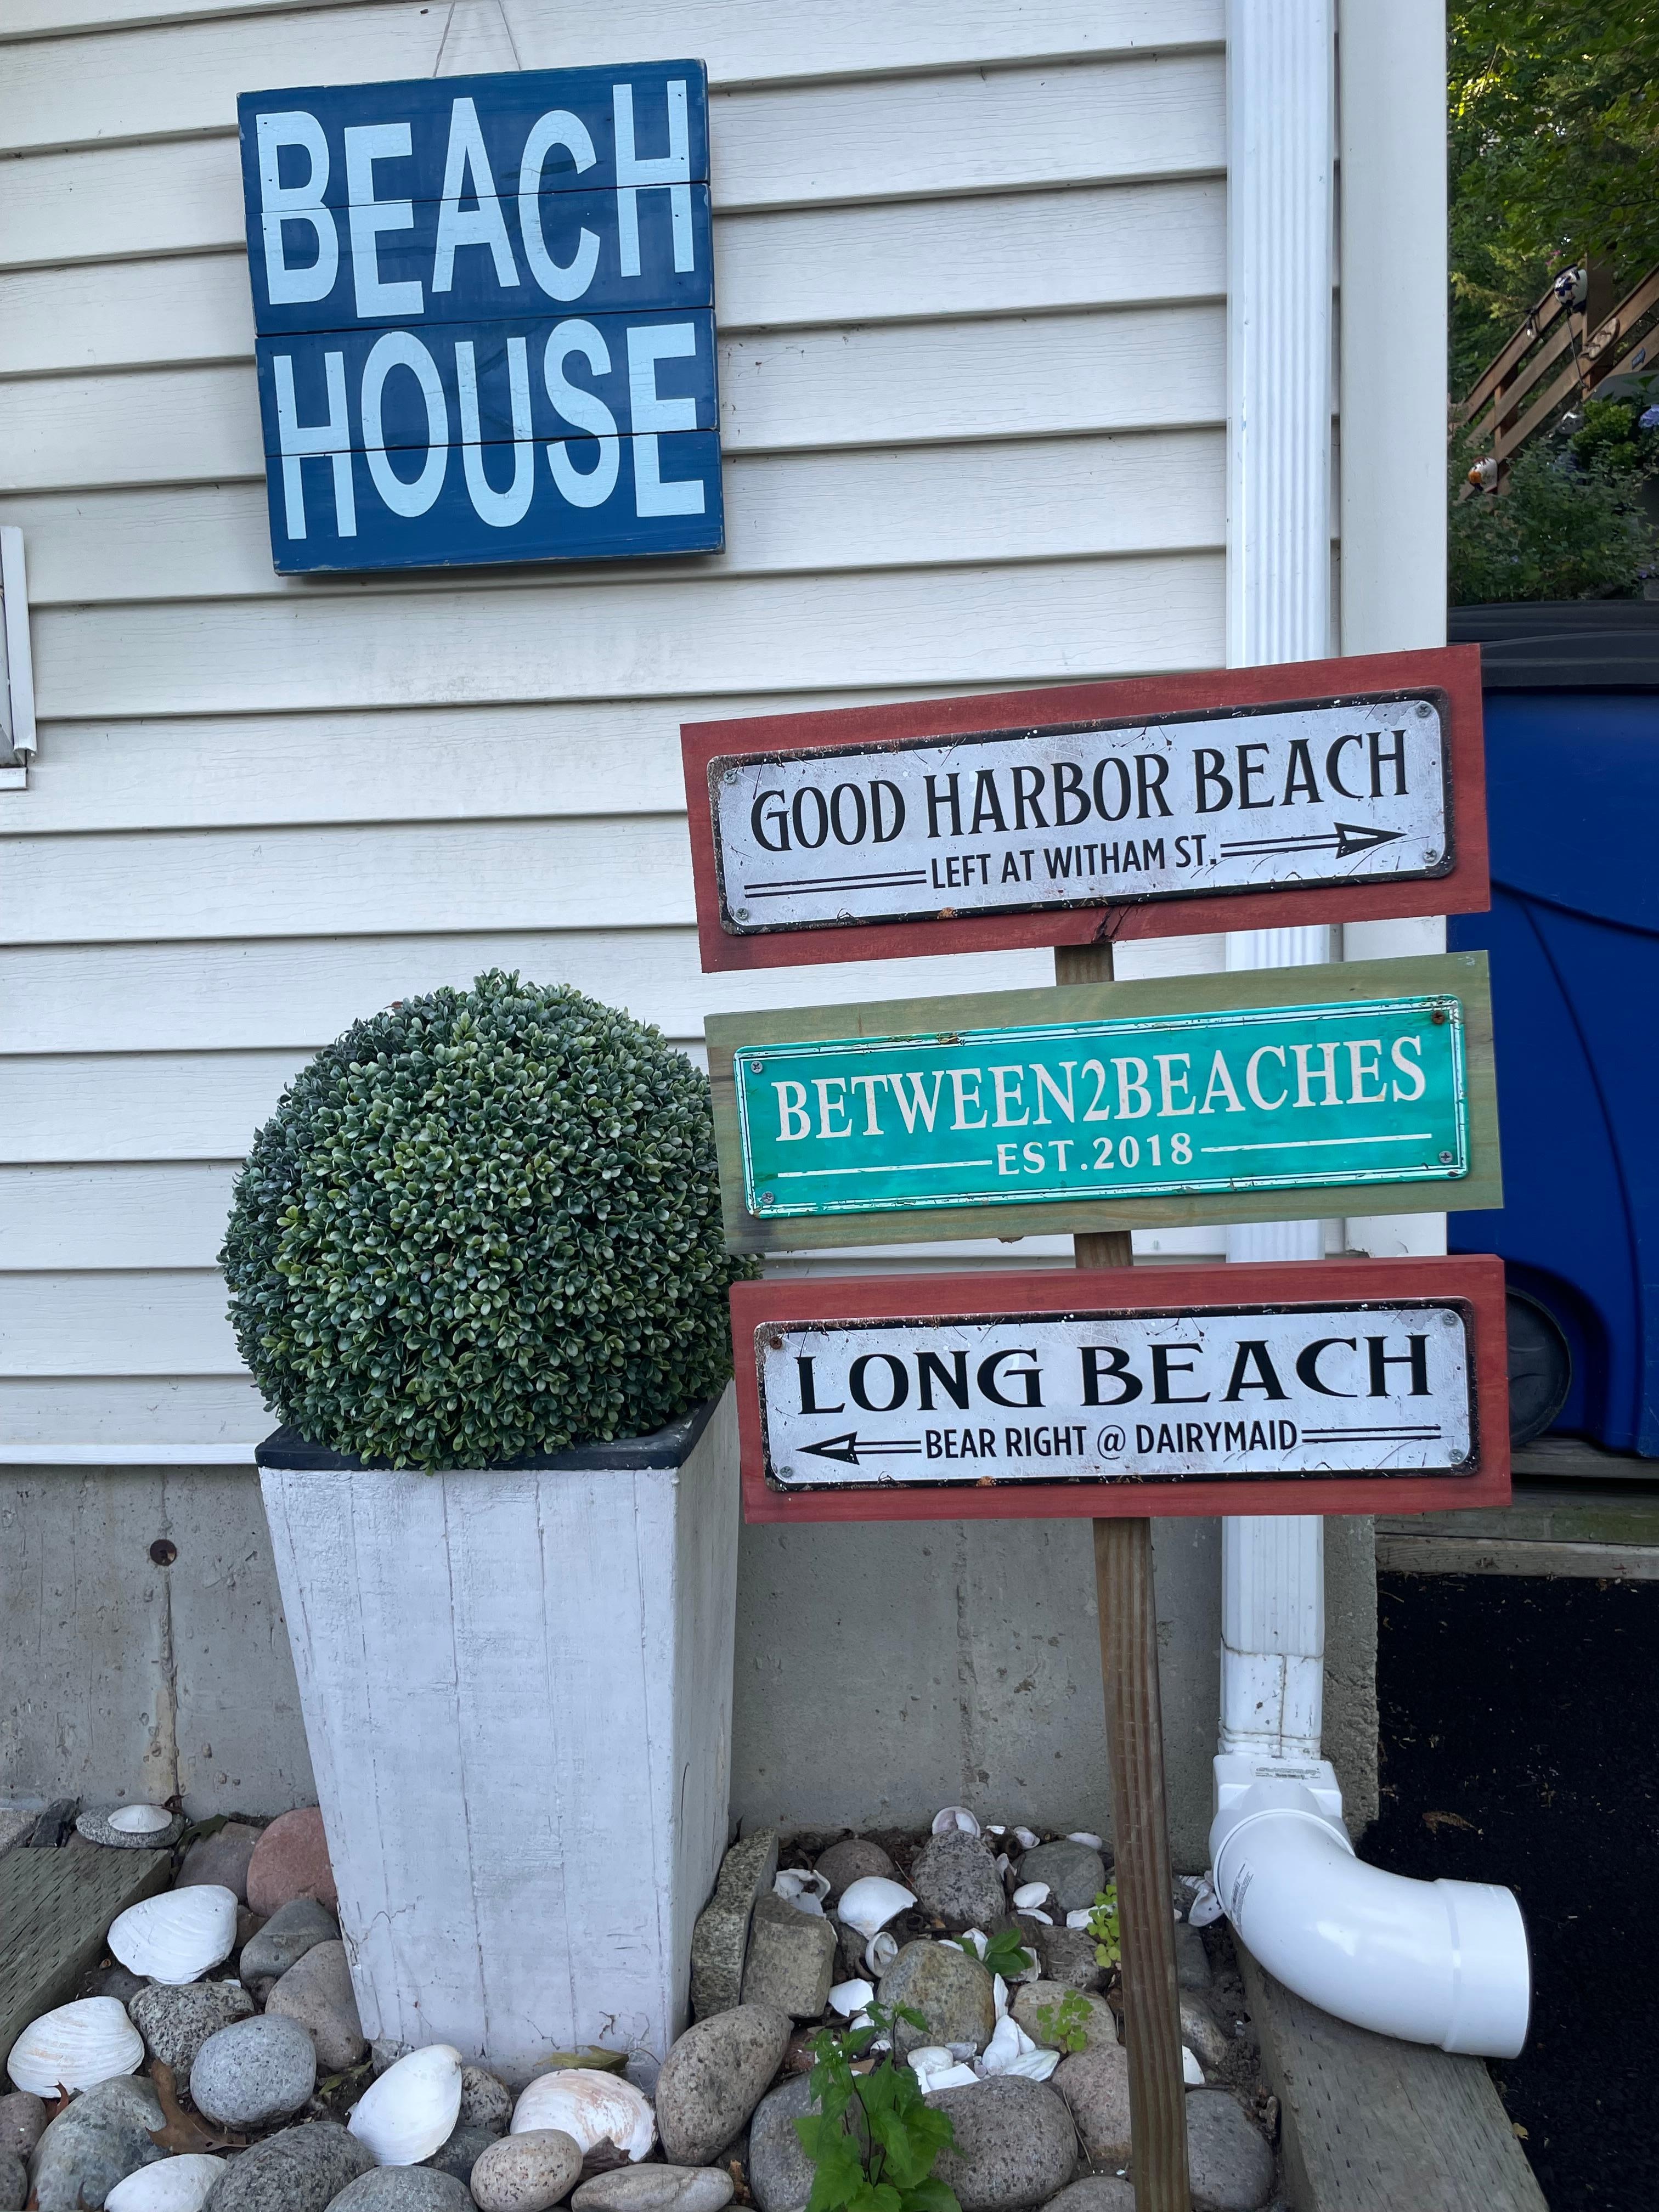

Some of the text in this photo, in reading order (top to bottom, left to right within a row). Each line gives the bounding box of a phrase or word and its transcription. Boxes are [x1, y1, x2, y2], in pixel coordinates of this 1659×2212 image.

[256, 80, 694, 318] BEACH
[273, 319, 705, 539] HOUSE
[751, 730, 1409, 851] GOOD HARBOR BEACH
[932, 834, 1217, 889] LEFT AT WITHAM ST.
[771, 1036, 1425, 1141] BETWEEN2BEACHES
[795, 1335, 1433, 1414] LONG BEACH
[926, 1420, 1297, 1460] BEAR RIGHT @ DAIRYMAID
